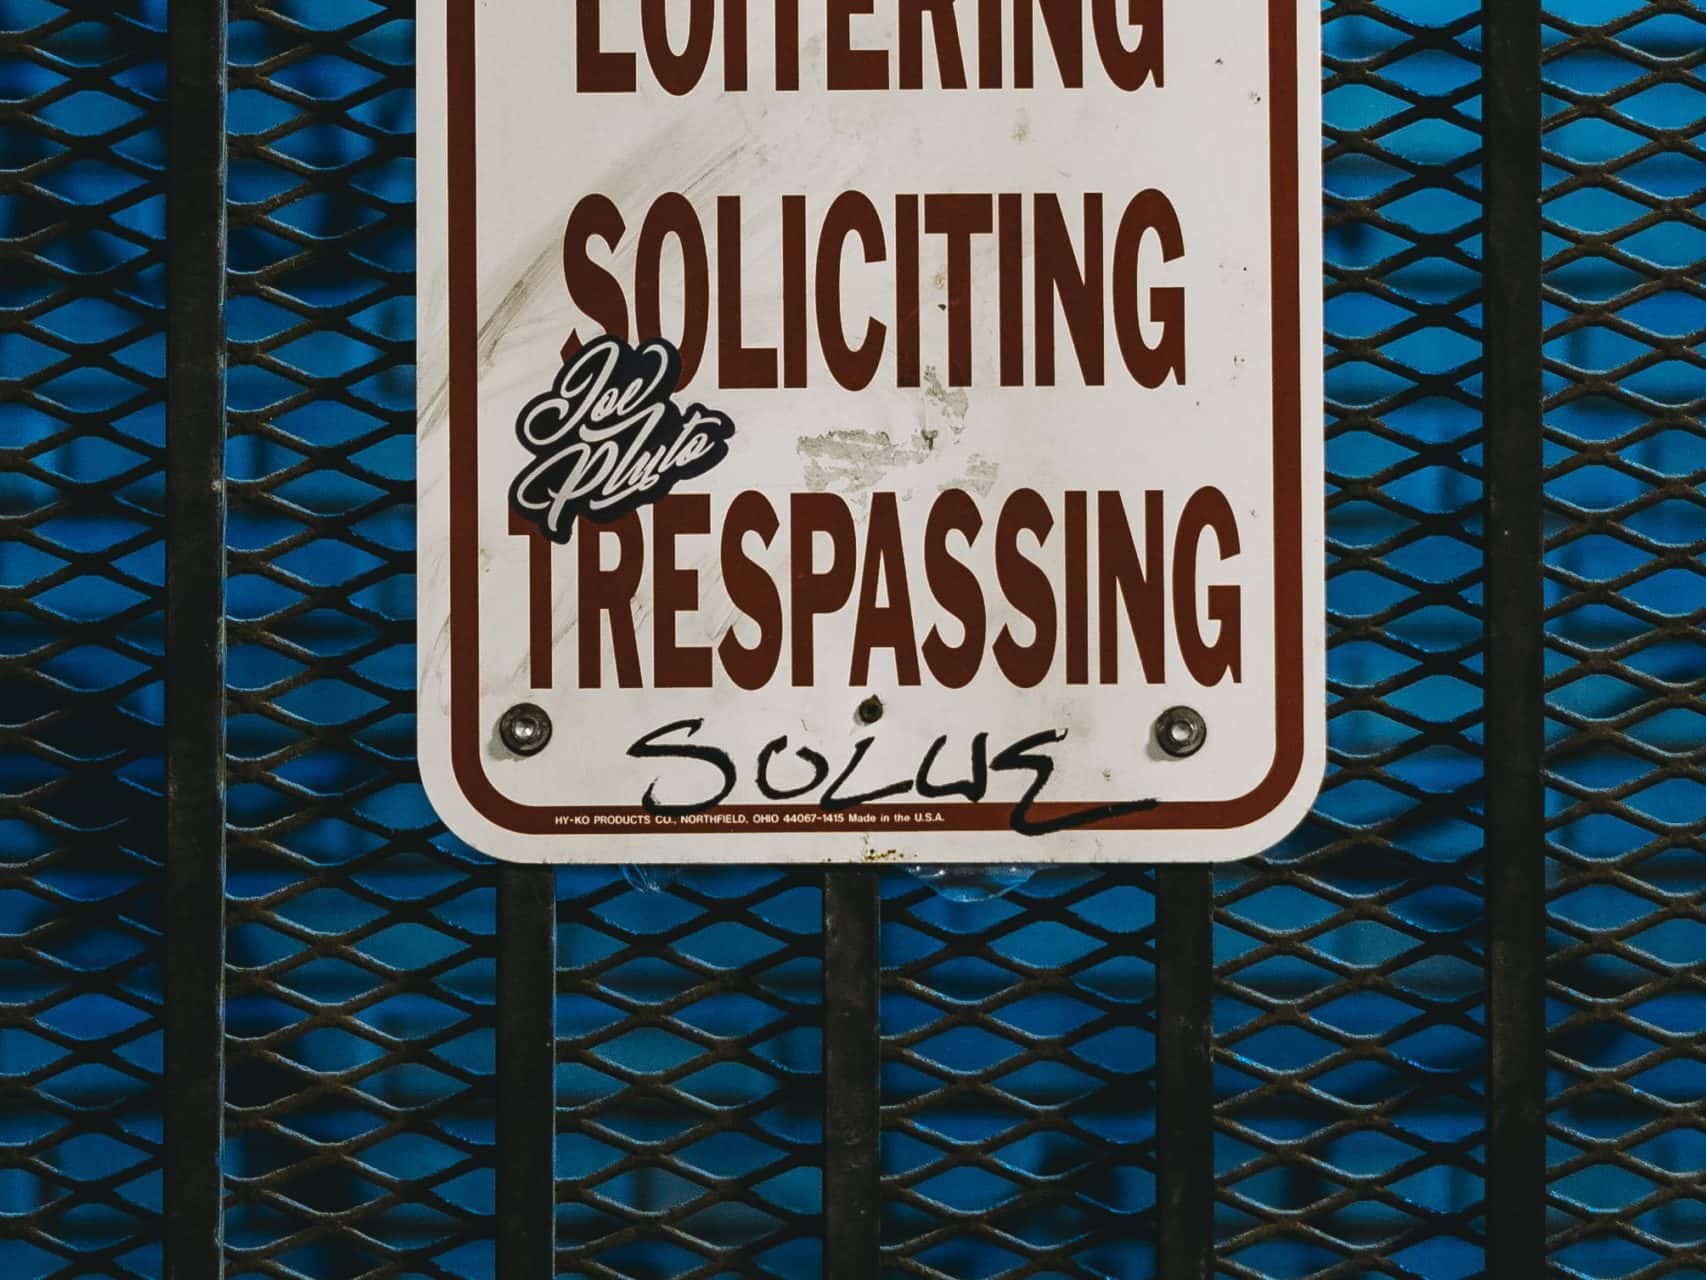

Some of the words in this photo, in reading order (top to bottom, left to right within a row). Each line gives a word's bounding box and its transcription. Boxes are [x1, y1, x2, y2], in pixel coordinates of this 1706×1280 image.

[560, 187, 1187, 392] SOLICITING
[522, 339, 670, 447] Joe
[515, 400, 724, 533] Pluto
[507, 485, 1244, 692] TRESPASSING
[554, 815, 591, 825] HY-KO
[593, 814, 652, 825] PRODUCTS
[752, 813, 780, 824] OHIO
[782, 812, 845, 824] 44067-1415
[848, 812, 877, 823] Made
[880, 812, 891, 823] in
[893, 812, 911, 823] the
[914, 812, 945, 823] U.S.A.
